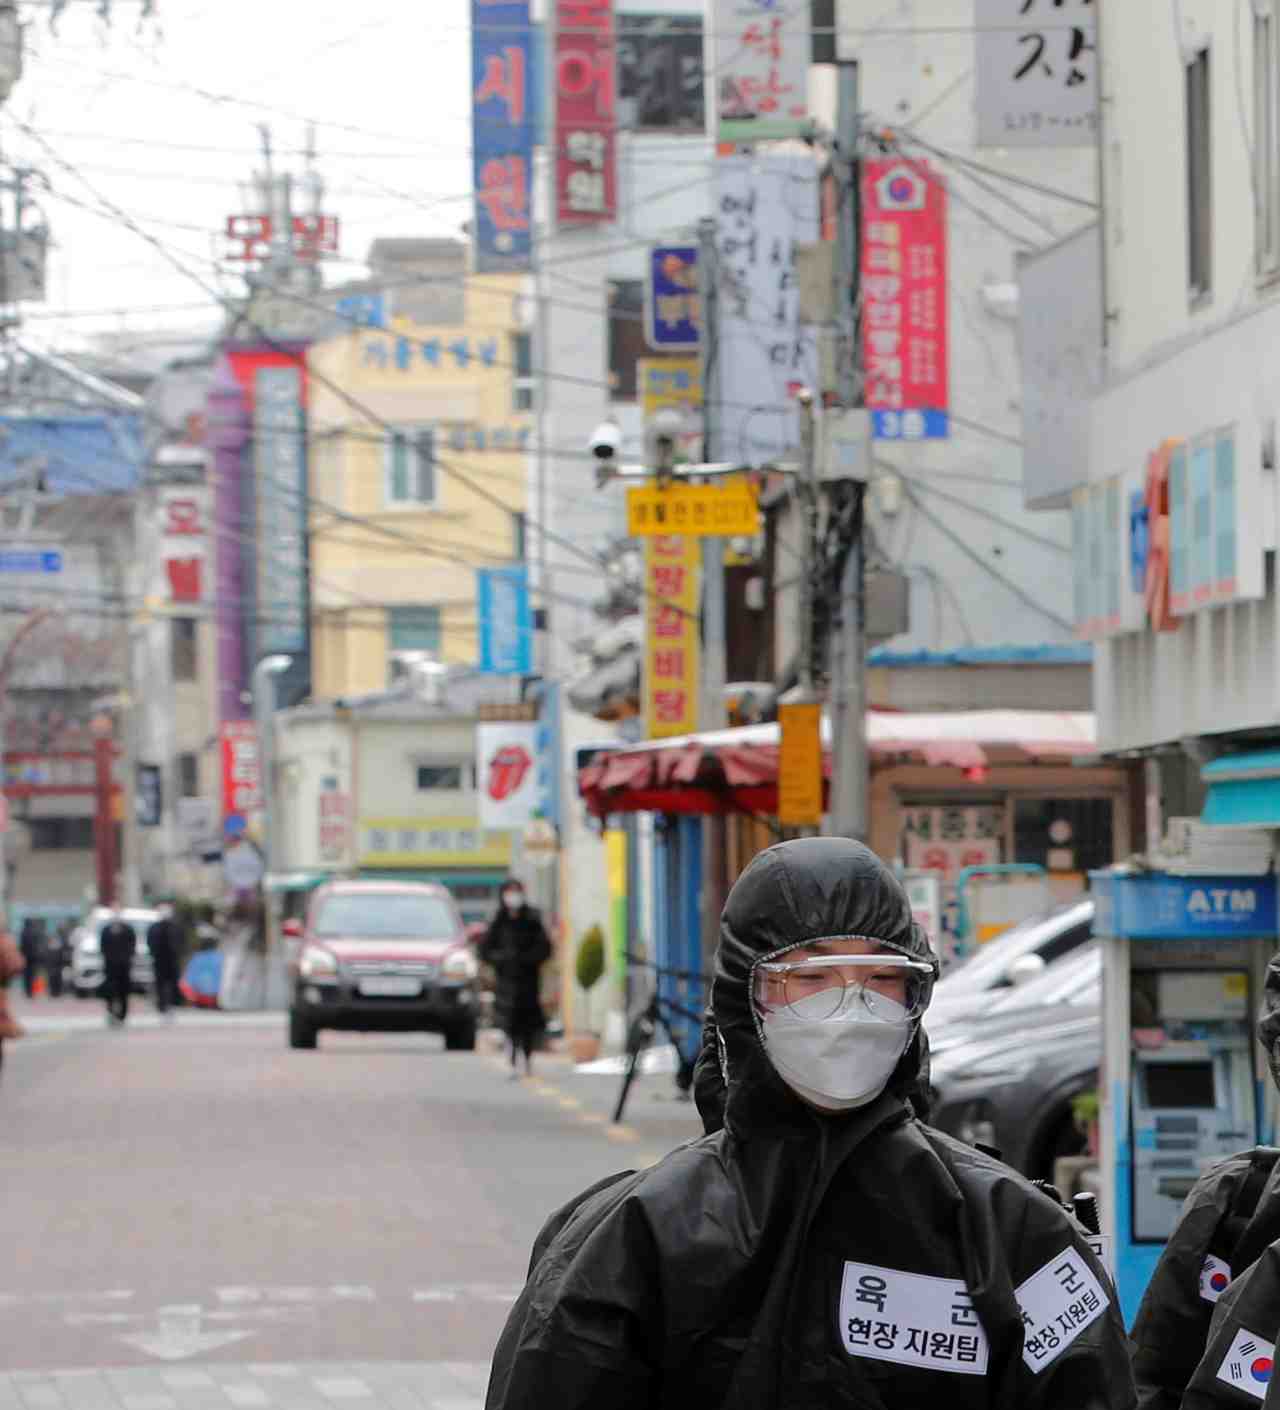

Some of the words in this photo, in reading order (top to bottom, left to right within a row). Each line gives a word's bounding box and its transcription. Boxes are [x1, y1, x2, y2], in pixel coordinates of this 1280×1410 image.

[1187, 889, 1256, 913] ATM
[855, 1275, 888, 1313] 육
[1054, 1261, 1085, 1295] 군
[847, 1316, 899, 1350] 현장
[903, 1327, 980, 1363] 지원팀
[1024, 1327, 1059, 1360] 현장
[1058, 1289, 1102, 1336] 지원팀
